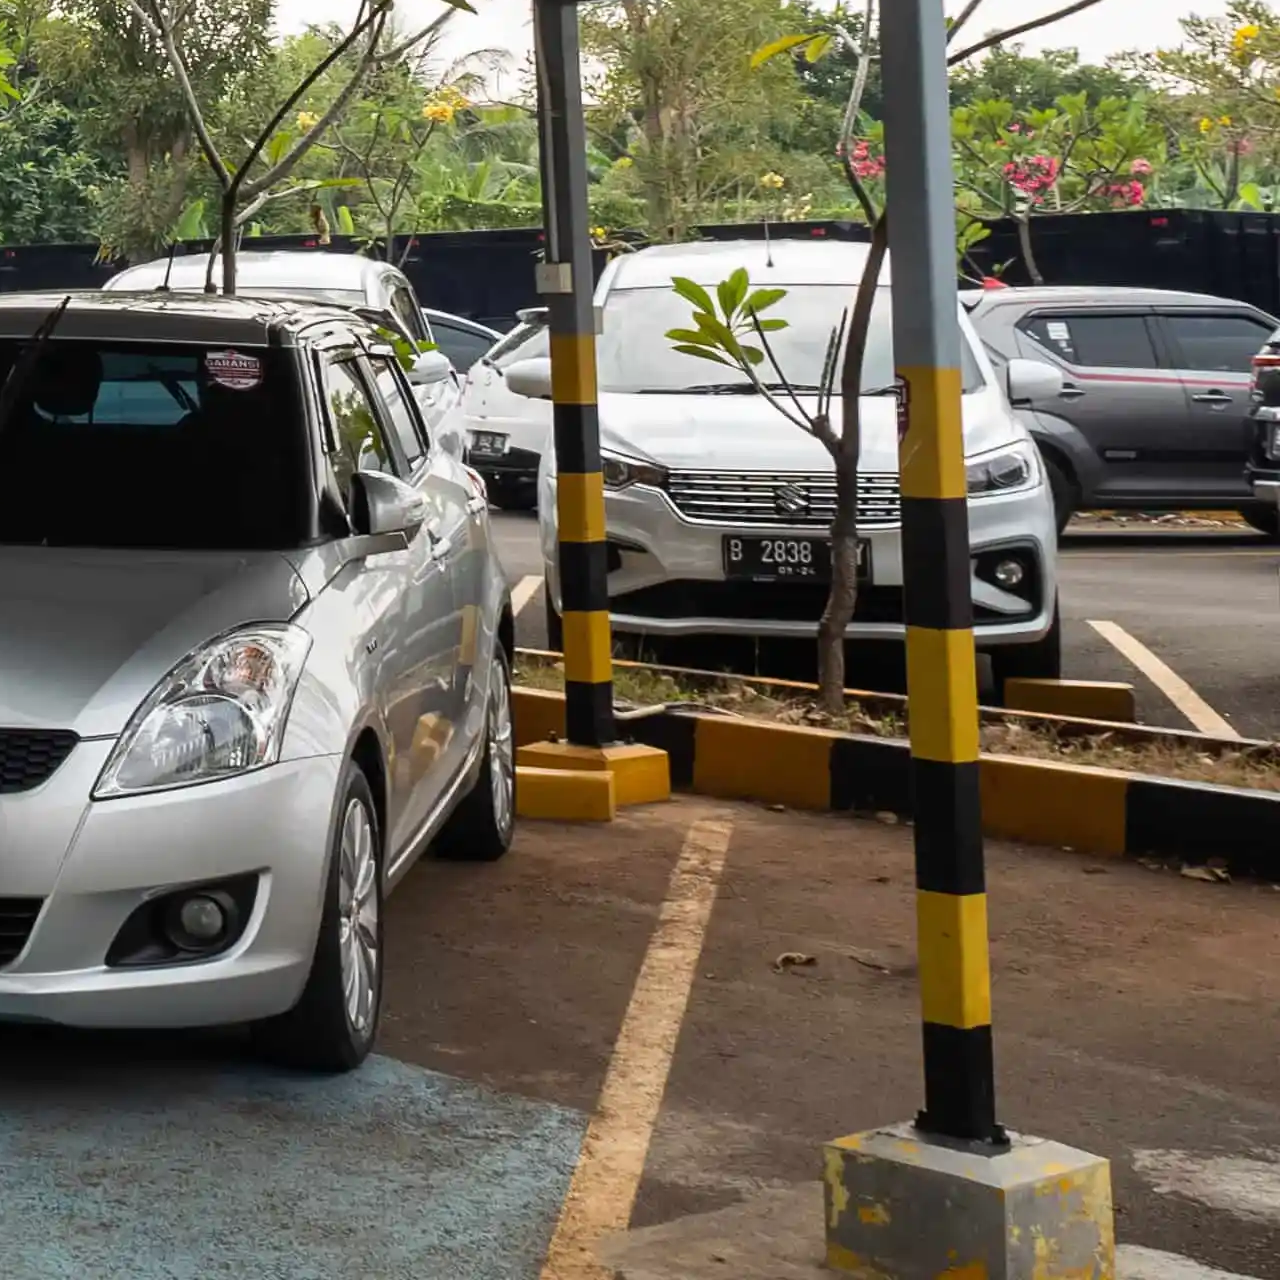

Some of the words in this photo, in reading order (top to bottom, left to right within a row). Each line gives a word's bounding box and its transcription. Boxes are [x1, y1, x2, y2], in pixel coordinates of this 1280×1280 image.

[204, 359, 260, 369] GARANSI
[730, 539, 743, 561] B
[760, 540, 812, 563] 2838
